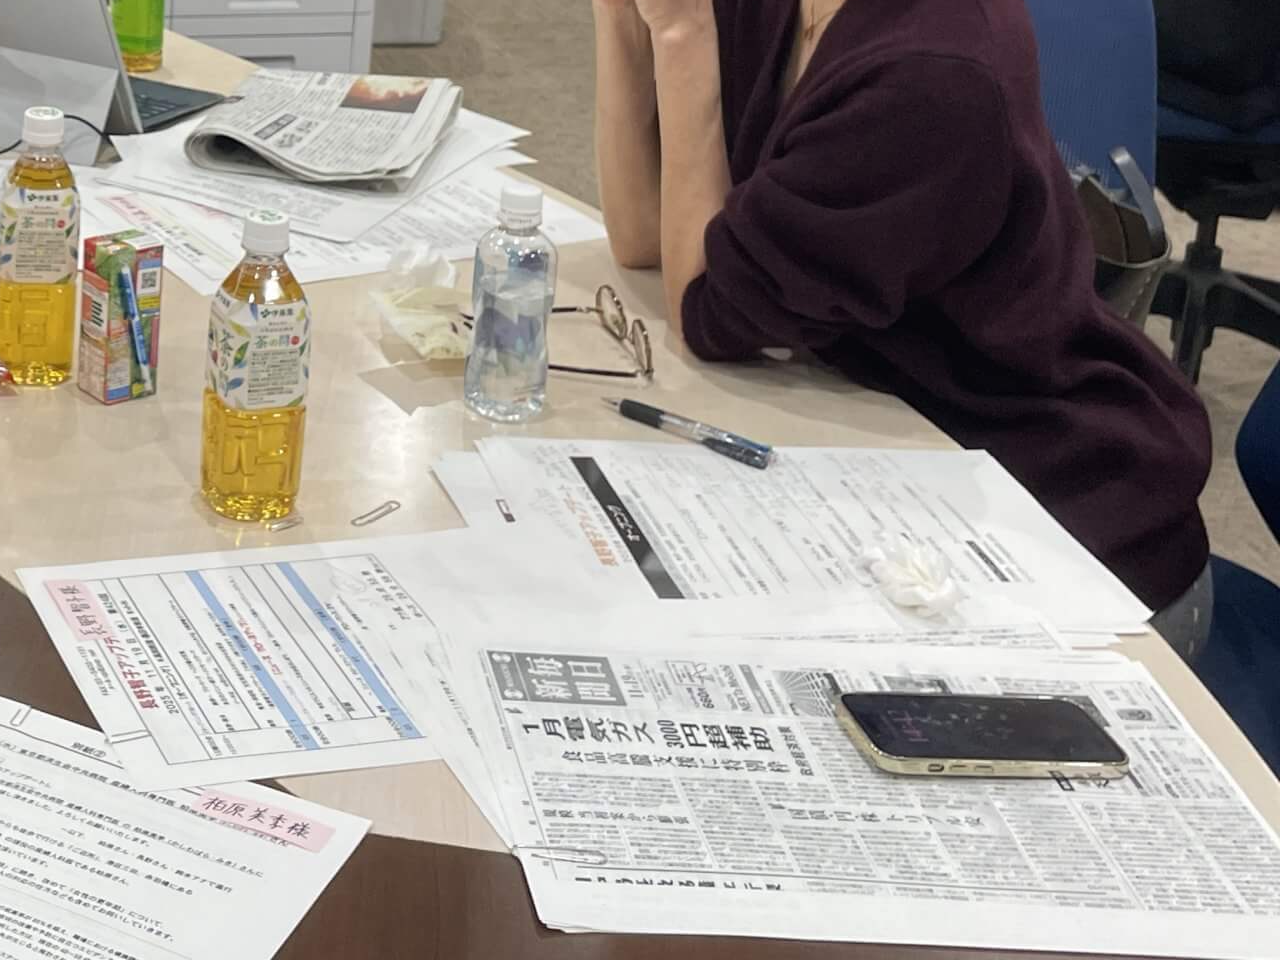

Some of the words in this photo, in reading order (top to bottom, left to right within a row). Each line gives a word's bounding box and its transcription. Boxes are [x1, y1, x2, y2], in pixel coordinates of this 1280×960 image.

[158, 695, 179, 714] 2025
[521, 715, 655, 744] 1月電気ガス
